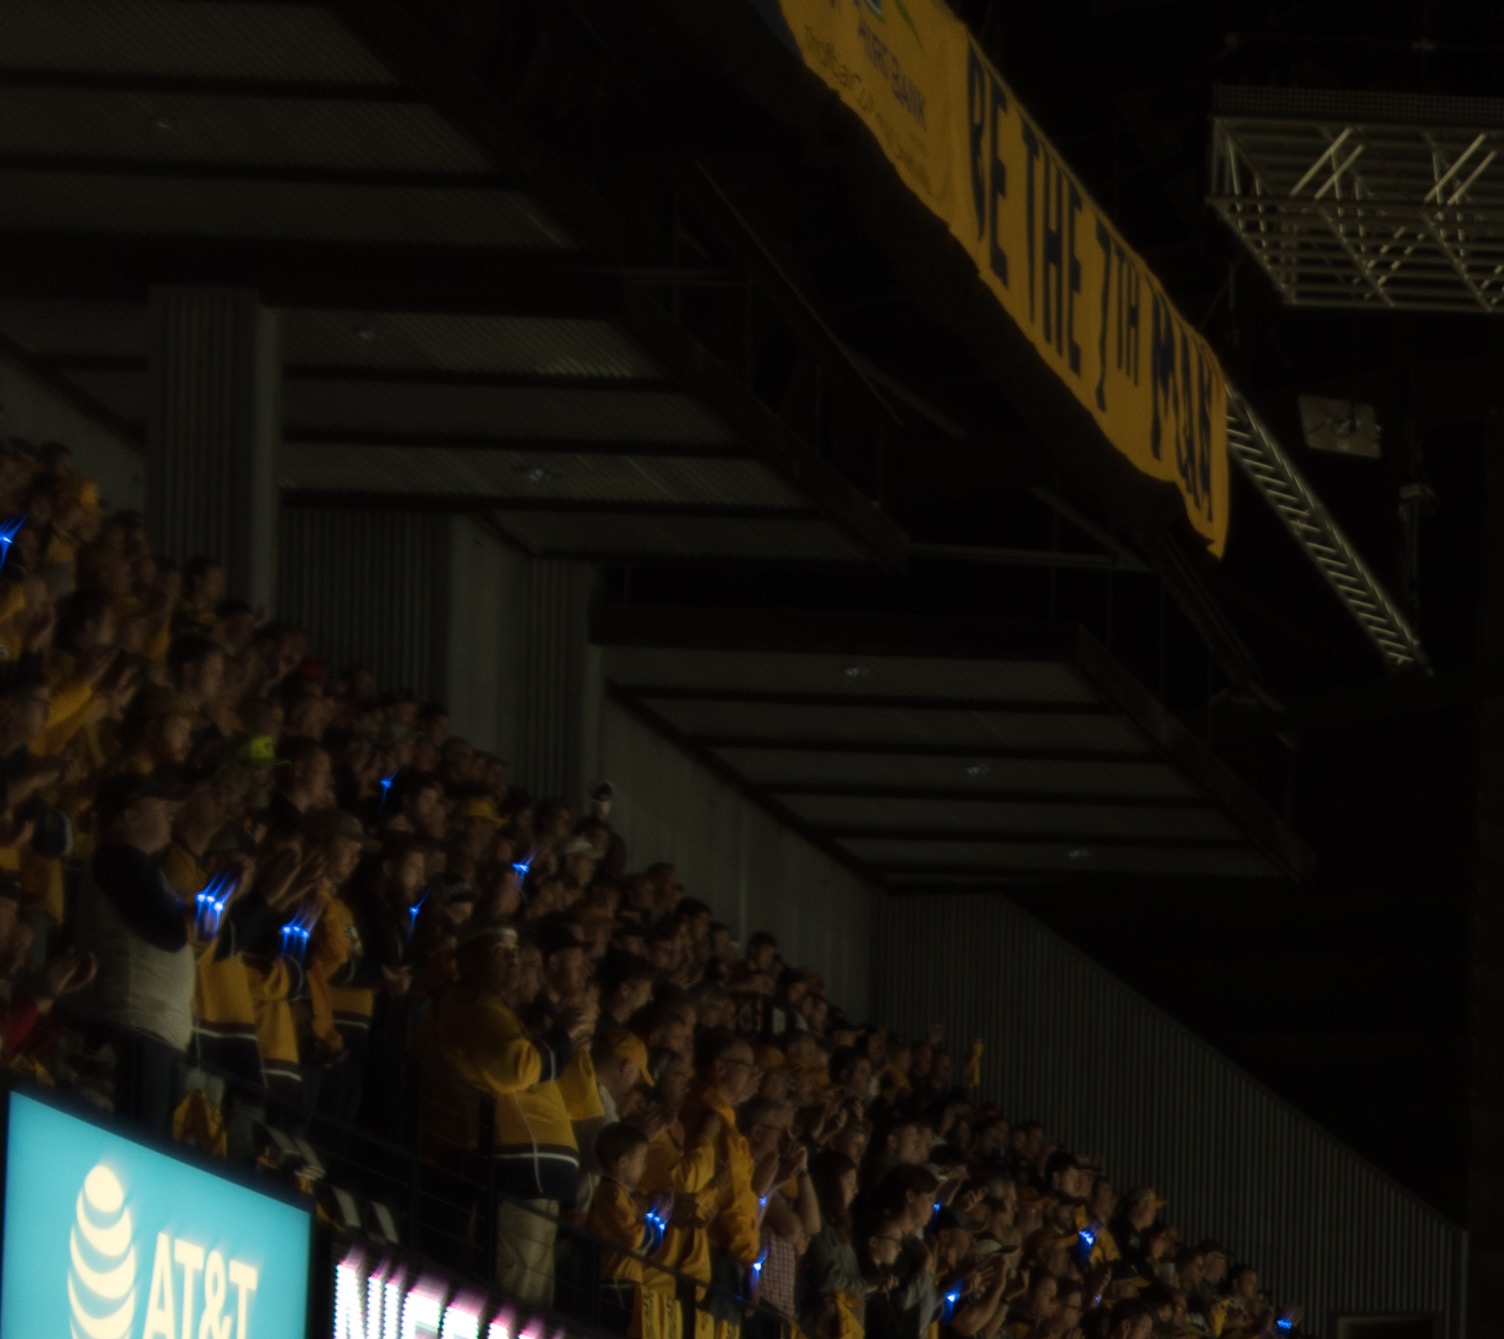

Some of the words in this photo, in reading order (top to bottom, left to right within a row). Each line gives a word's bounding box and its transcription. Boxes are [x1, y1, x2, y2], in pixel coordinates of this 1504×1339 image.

[965, 46, 1009, 290] BE
[1020, 117, 1083, 380] THE
[1149, 287, 1215, 525] MAN
